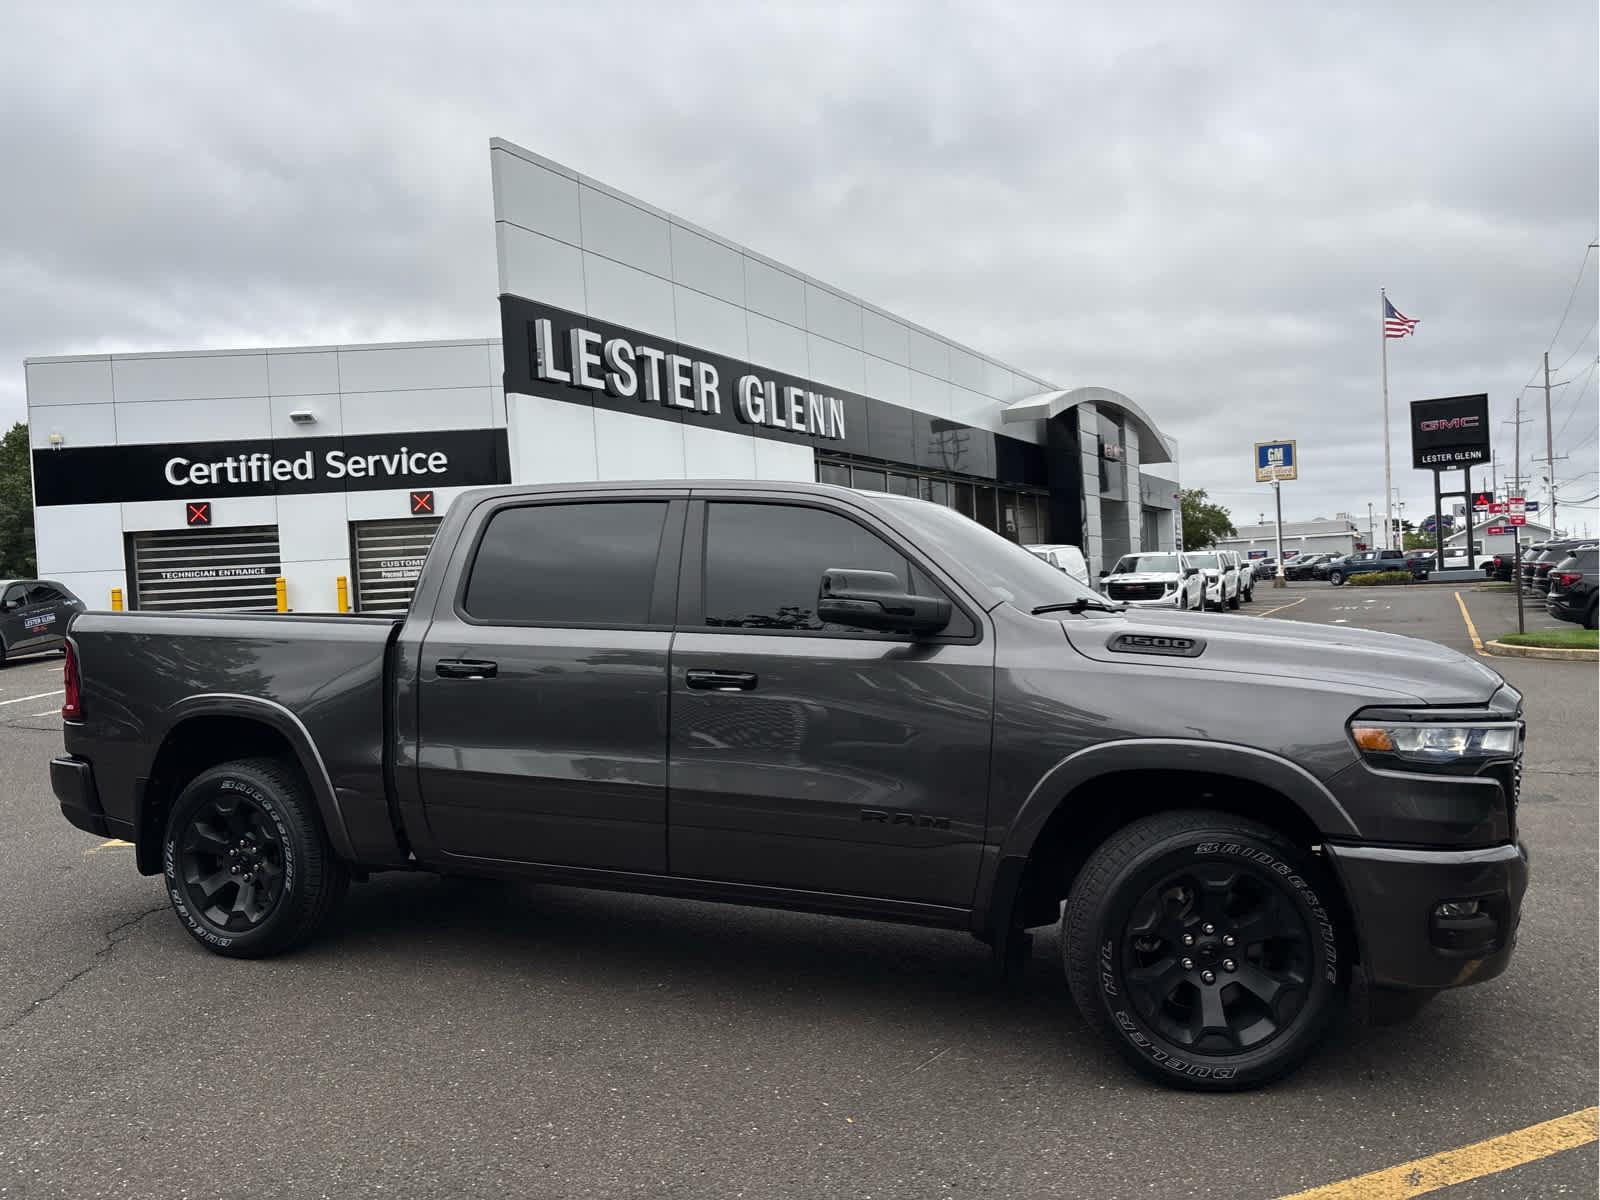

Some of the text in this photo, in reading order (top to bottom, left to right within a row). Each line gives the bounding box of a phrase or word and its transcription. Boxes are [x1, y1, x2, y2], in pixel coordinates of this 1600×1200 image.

[535, 318, 846, 439] LESTER GLENN
[1421, 416, 1480, 431] GMC
[1267, 447, 1284, 461] GM
[1422, 451, 1482, 463] LESTER GLENN
[164, 446, 449, 486] Certified Service
[162, 567, 266, 579] TECHNICIAN ENTRANCE
[1124, 636, 1193, 648] 1500
[1194, 842, 1337, 984] BRIDGESTONE
[1115, 1010, 1239, 1079] DUELER
